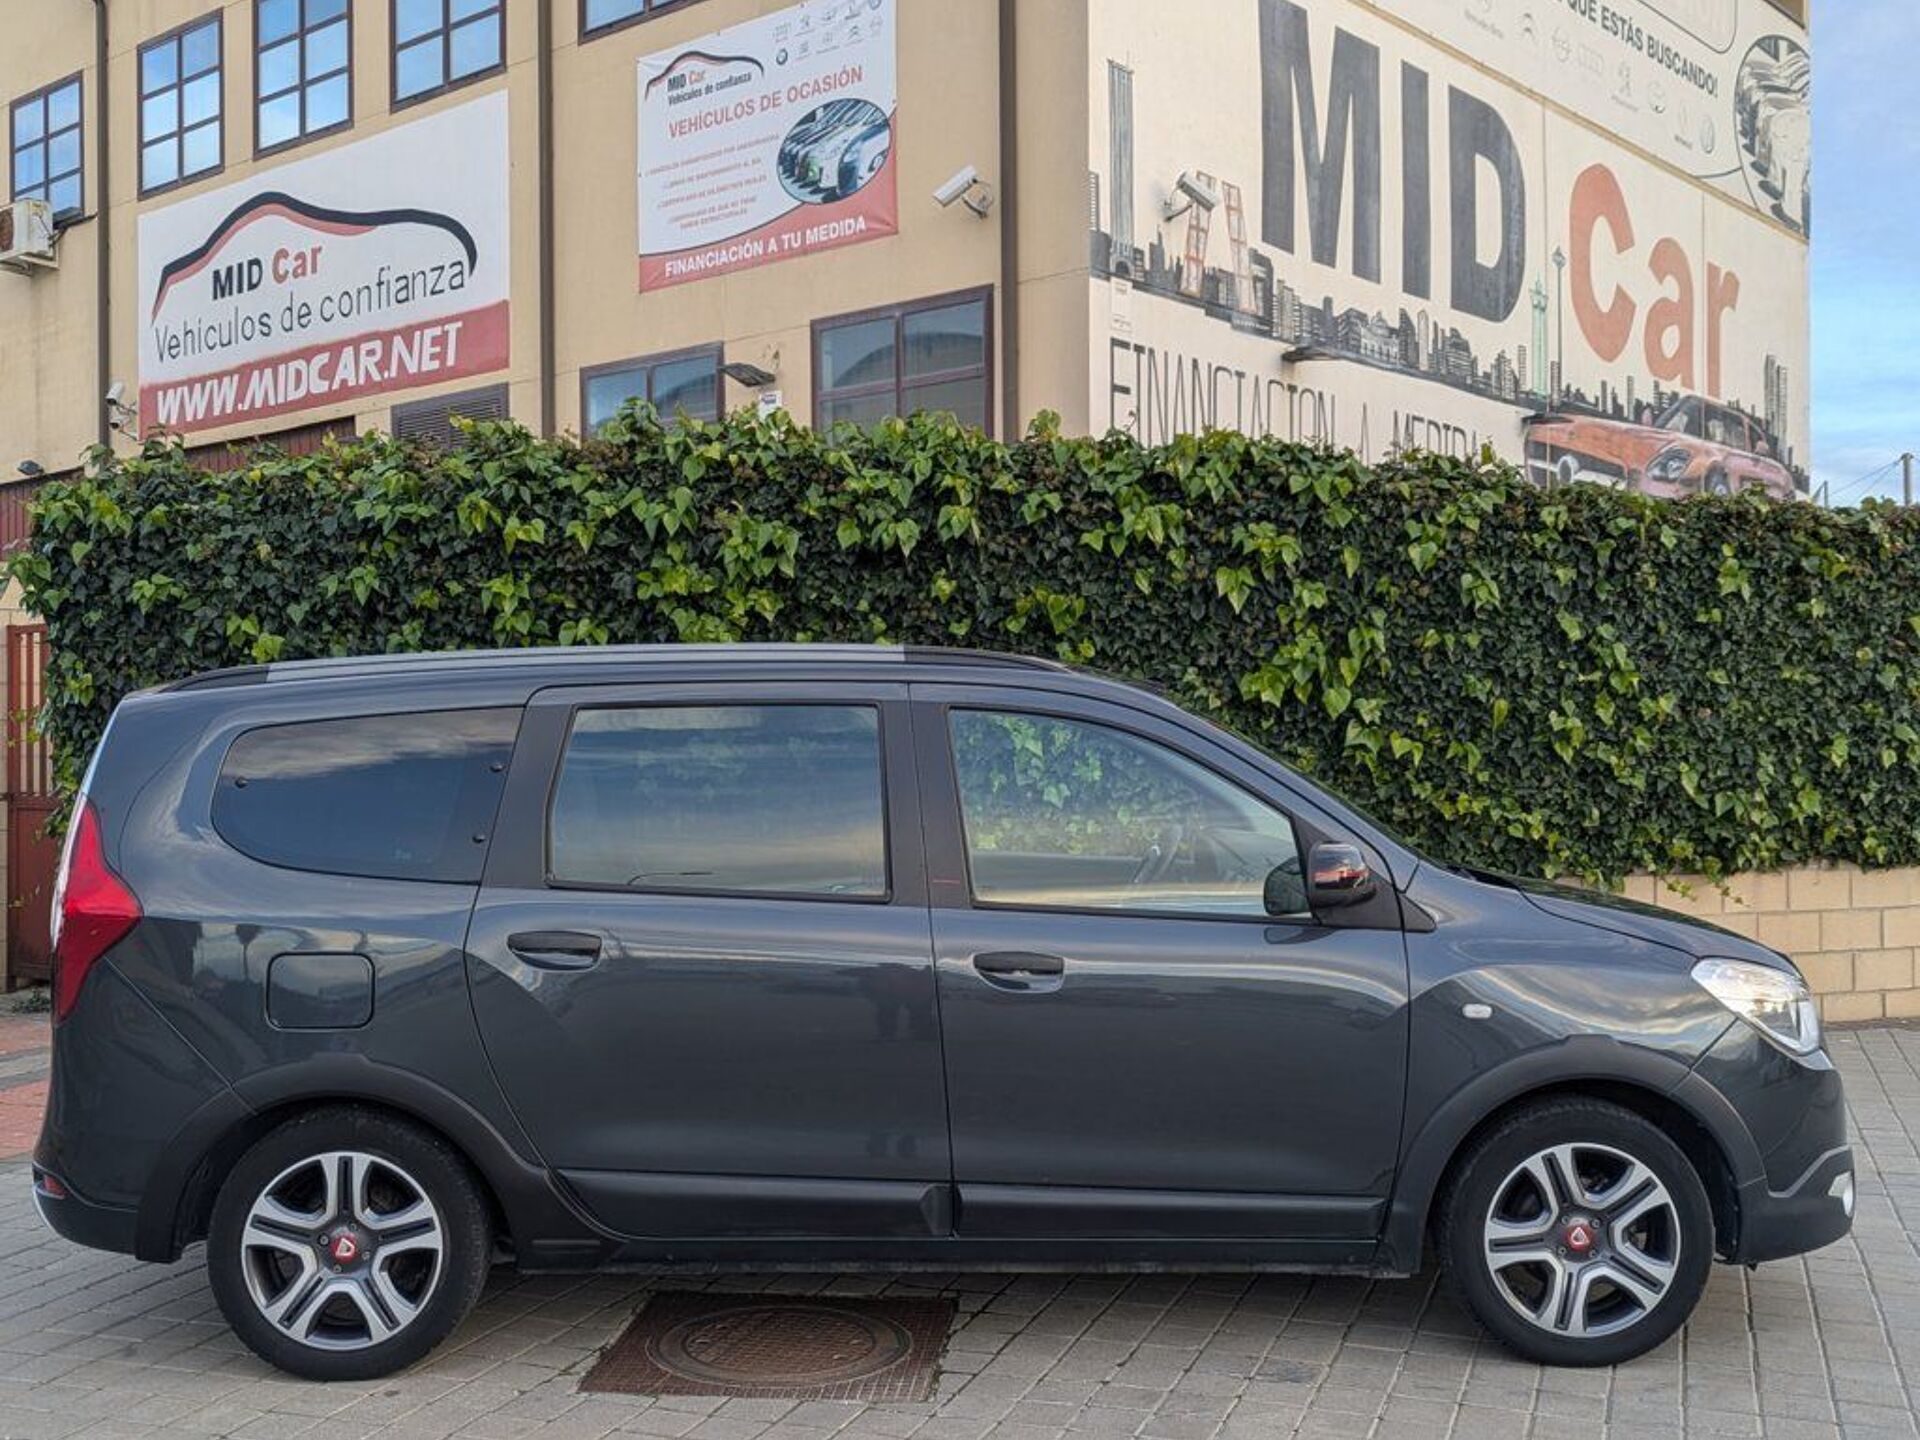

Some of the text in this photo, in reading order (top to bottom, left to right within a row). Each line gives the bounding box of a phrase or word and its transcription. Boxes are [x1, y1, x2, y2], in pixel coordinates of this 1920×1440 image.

[667, 73, 687, 92] MID
[1601, 6, 1643, 51] ESTÁS
[1647, 34, 1718, 98] BUSCANDO!
[760, 91, 782, 112] DE
[787, 65, 863, 102] OCASIÓN
[1258, 0, 1740, 398] MID Car
[212, 244, 323, 300] MID Car
[665, 216, 866, 277] FINANCIACIÓN A TU MEDIDA
[280, 291, 312, 333] de
[320, 259, 465, 322] confianza
[156, 322, 463, 425] WWW.MIDCAR.NET
